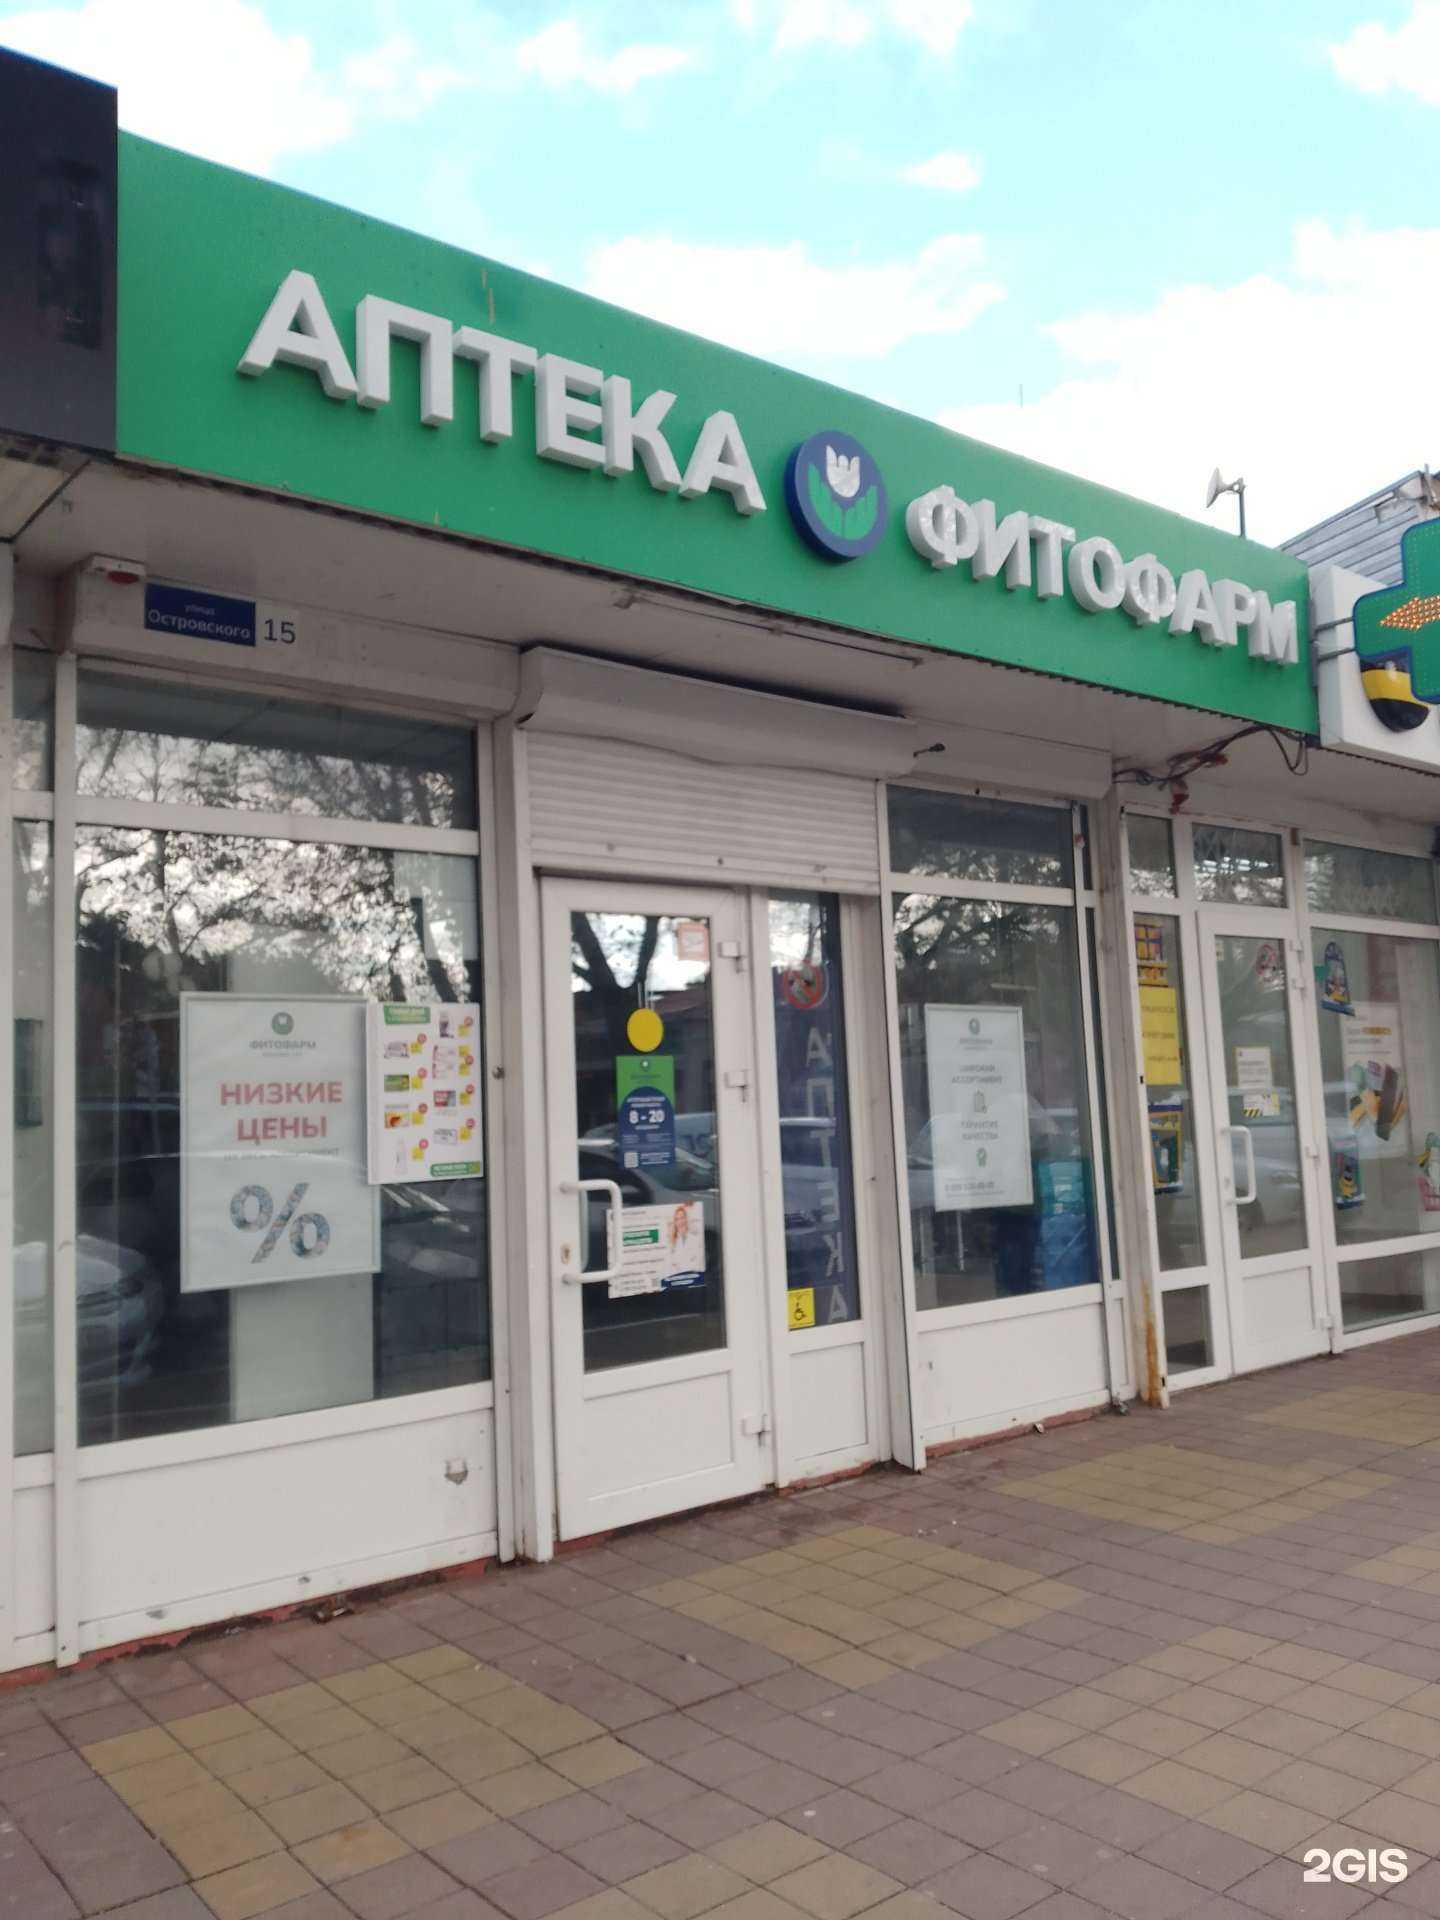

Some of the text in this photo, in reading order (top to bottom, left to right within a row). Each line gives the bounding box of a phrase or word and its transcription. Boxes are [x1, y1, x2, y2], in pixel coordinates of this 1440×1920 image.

[237, 269, 1299, 665] АПТЕКА ФИТОФАРМ
[148, 608, 296, 644] Островского 15
[220, 1081, 343, 1106] НИЗКИЕ
[237, 1116, 328, 1146] ЦЕНЫ
